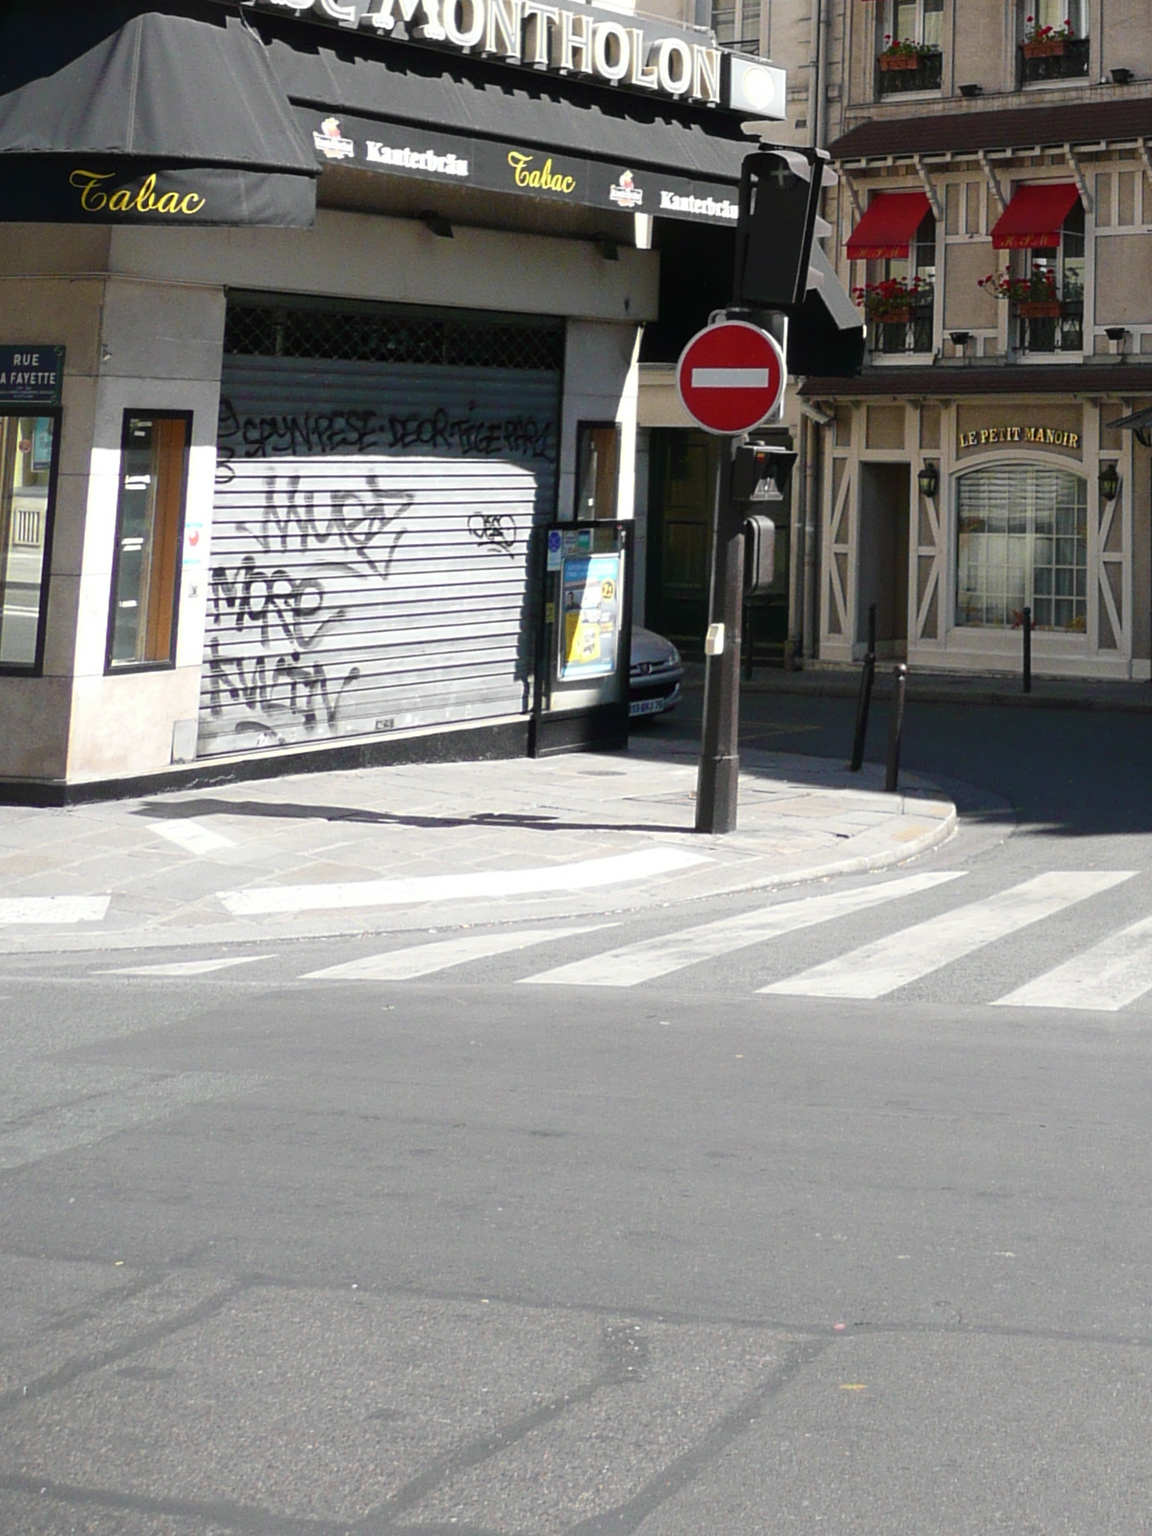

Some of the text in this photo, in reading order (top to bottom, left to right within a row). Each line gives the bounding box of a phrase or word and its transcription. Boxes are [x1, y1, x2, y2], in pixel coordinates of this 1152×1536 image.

[507, 151, 576, 193] Tabac
[69, 169, 206, 214] Tabac
[13, 354, 40, 366] RUE
[10, 372, 56, 385] FAYETTE
[959, 427, 1079, 449] LE PETIT MANOIR
